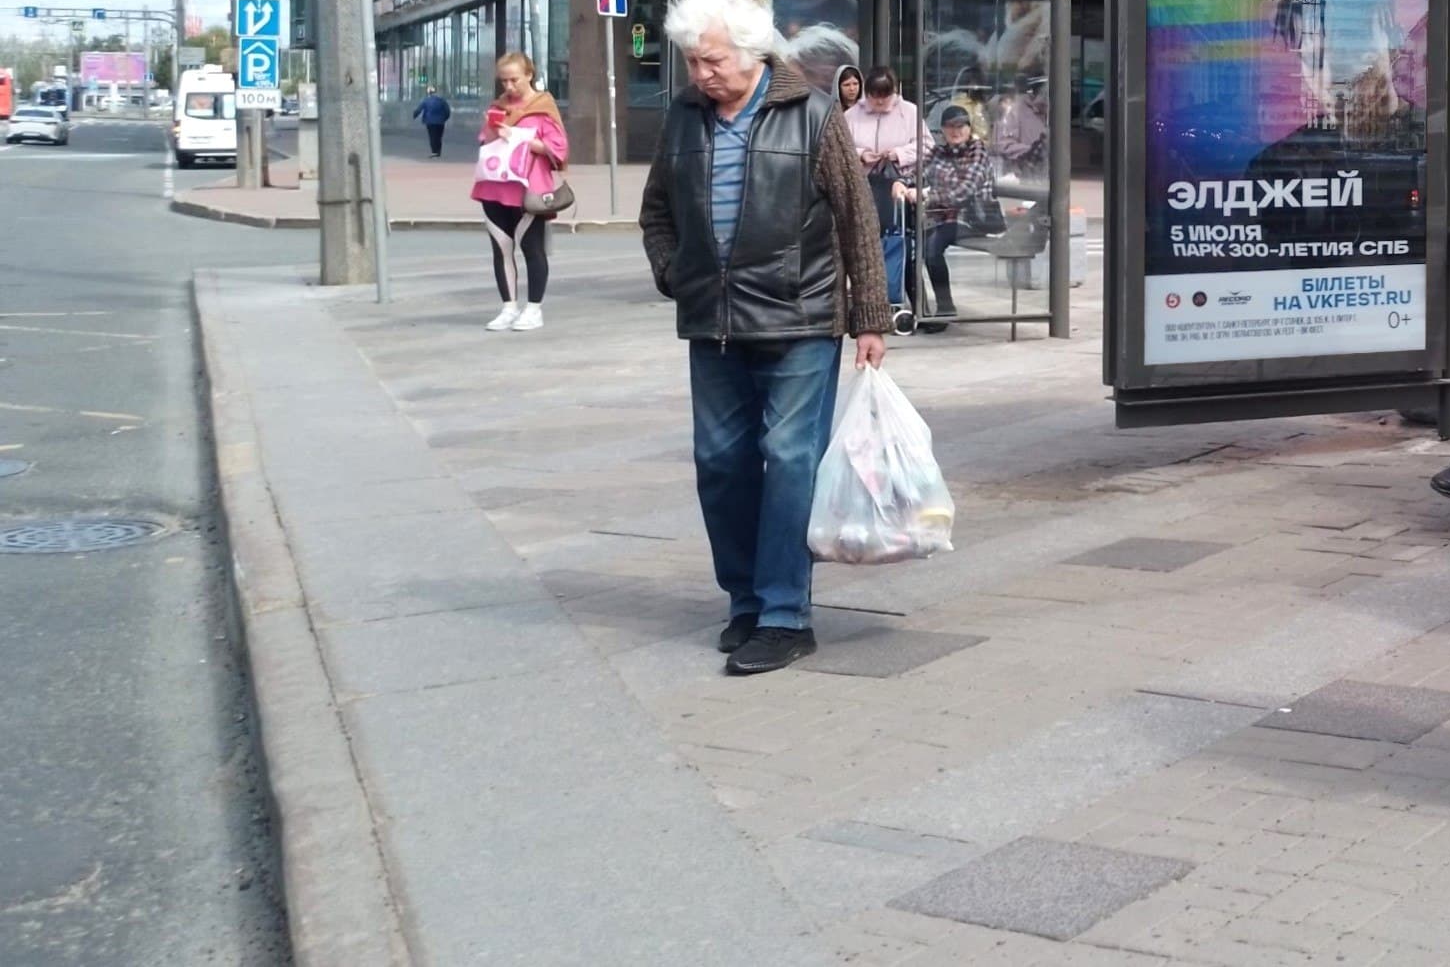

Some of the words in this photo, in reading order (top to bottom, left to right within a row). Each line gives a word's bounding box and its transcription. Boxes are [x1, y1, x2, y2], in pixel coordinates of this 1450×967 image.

[1167, 170, 1363, 216] ЭЛДЖЕЙ
[1171, 225, 1184, 241] 5
[1189, 225, 1262, 241] ИЮЛЯ
[1173, 243, 1225, 257] ПАРК
[1229, 241, 1353, 257] 300-ЛЕТИЯ
[1359, 240, 1410, 255] СПБ
[1302, 275, 1385, 292] БИЛЕТЫ
[1274, 296, 1302, 311] НА
[1308, 290, 1412, 310] VKFEST.RU
[1388, 311, 1411, 329] 0+
